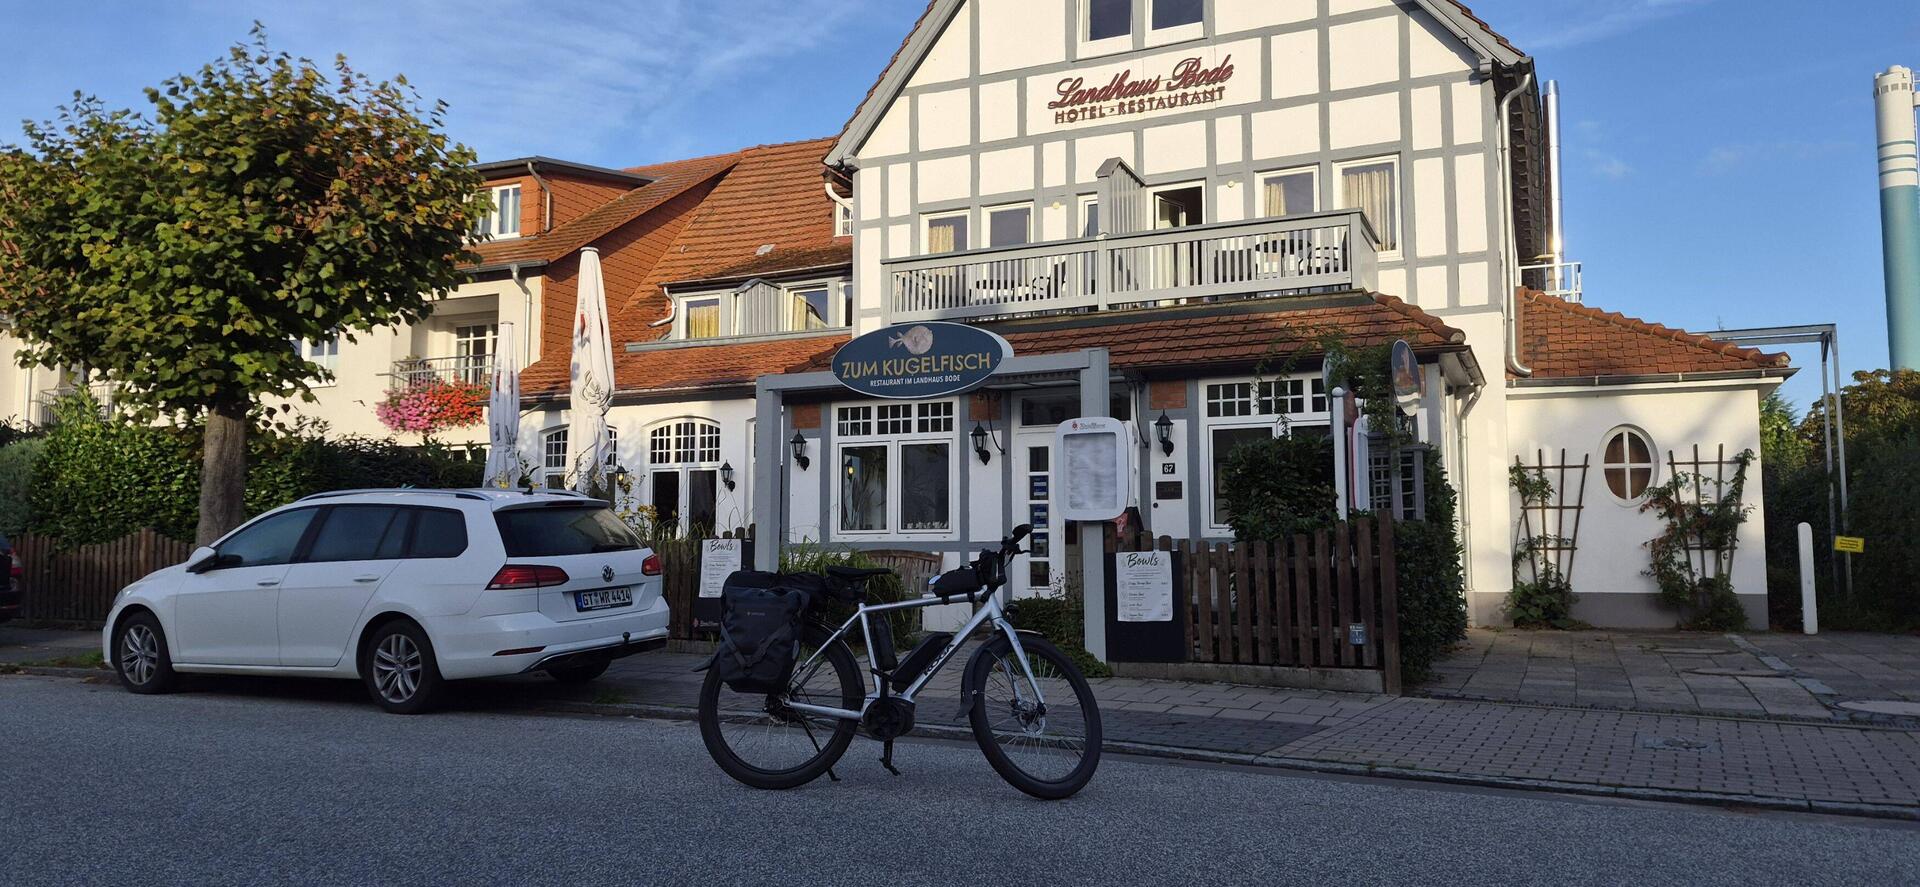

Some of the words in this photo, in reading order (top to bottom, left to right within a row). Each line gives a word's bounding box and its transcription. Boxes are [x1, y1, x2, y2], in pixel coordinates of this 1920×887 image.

[1048, 69, 1161, 109] Landhaus
[1166, 54, 1234, 92] Bode
[1055, 105, 1106, 124] HOTEL
[1118, 86, 1226, 115] RESTAURANT
[842, 361, 878, 379] ZUM
[882, 352, 991, 377] KUGELFISCH
[870, 378, 904, 387] RESTAURANT
[913, 375, 943, 384] LANDHAUS
[944, 374, 961, 382] BODE
[1163, 464, 1173, 473] 67
[709, 540, 733, 553] Bowls
[1126, 552, 1160, 568] Bowls
[582, 593, 593, 606] GT
[599, 591, 611, 604] WR
[611, 588, 630, 603] 4414
[923, 644, 955, 676] KOGA
